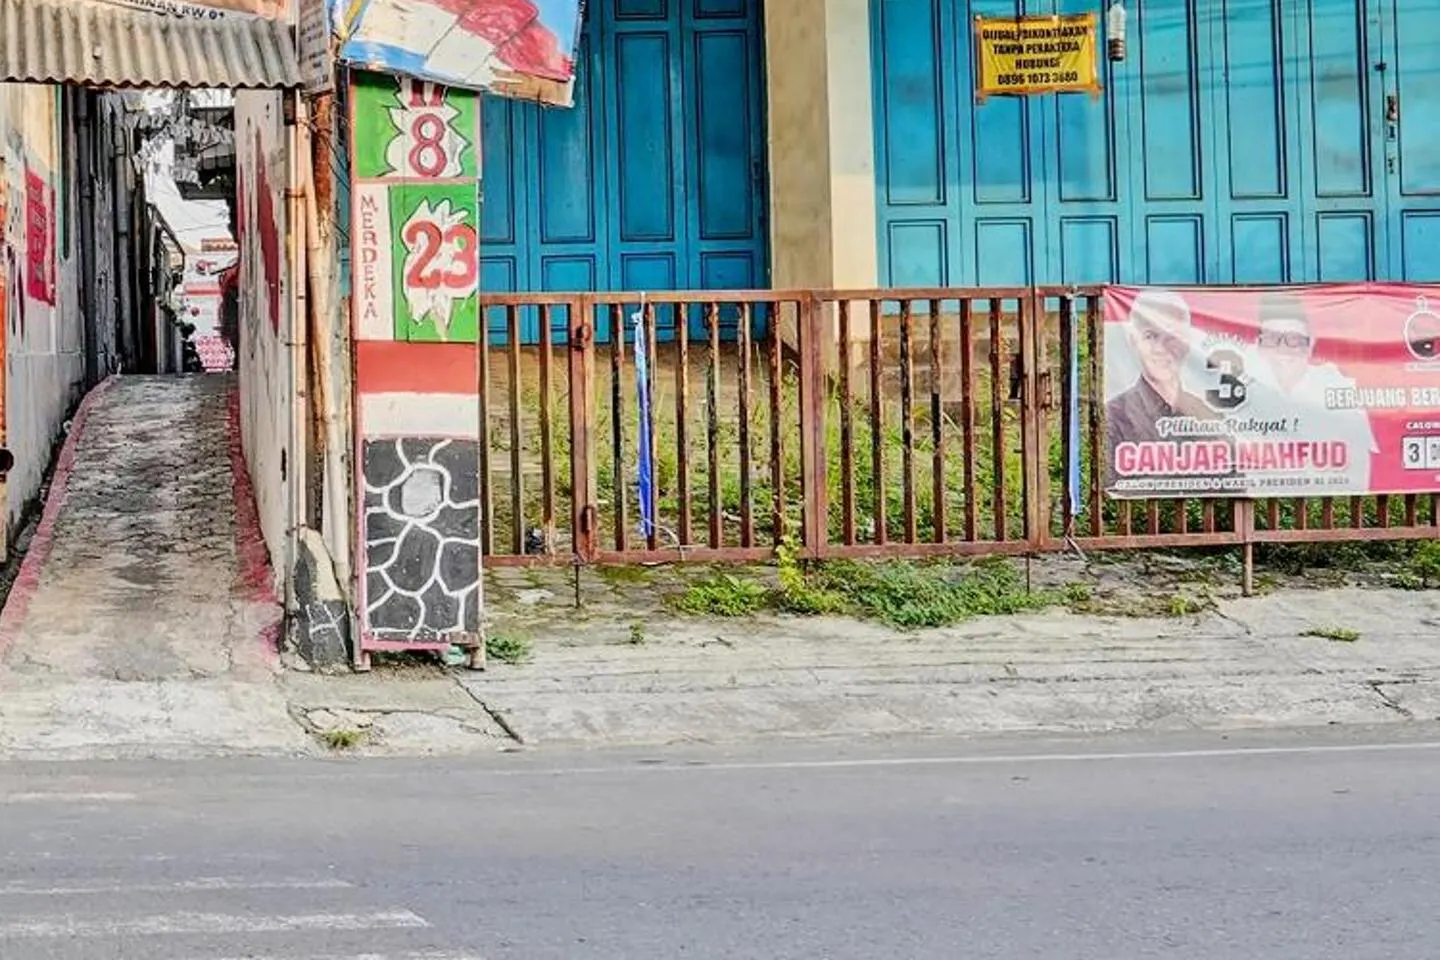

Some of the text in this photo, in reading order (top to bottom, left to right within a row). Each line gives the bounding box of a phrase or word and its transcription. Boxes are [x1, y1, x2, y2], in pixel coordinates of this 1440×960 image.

[408, 113, 448, 177] 8
[360, 194, 379, 319] MERDEKA
[406, 220, 477, 290] 23
[1205, 348, 1248, 410] 3
[1116, 440, 1348, 473] GANJAR MAHFUD
[1408, 443, 1420, 463] 3
